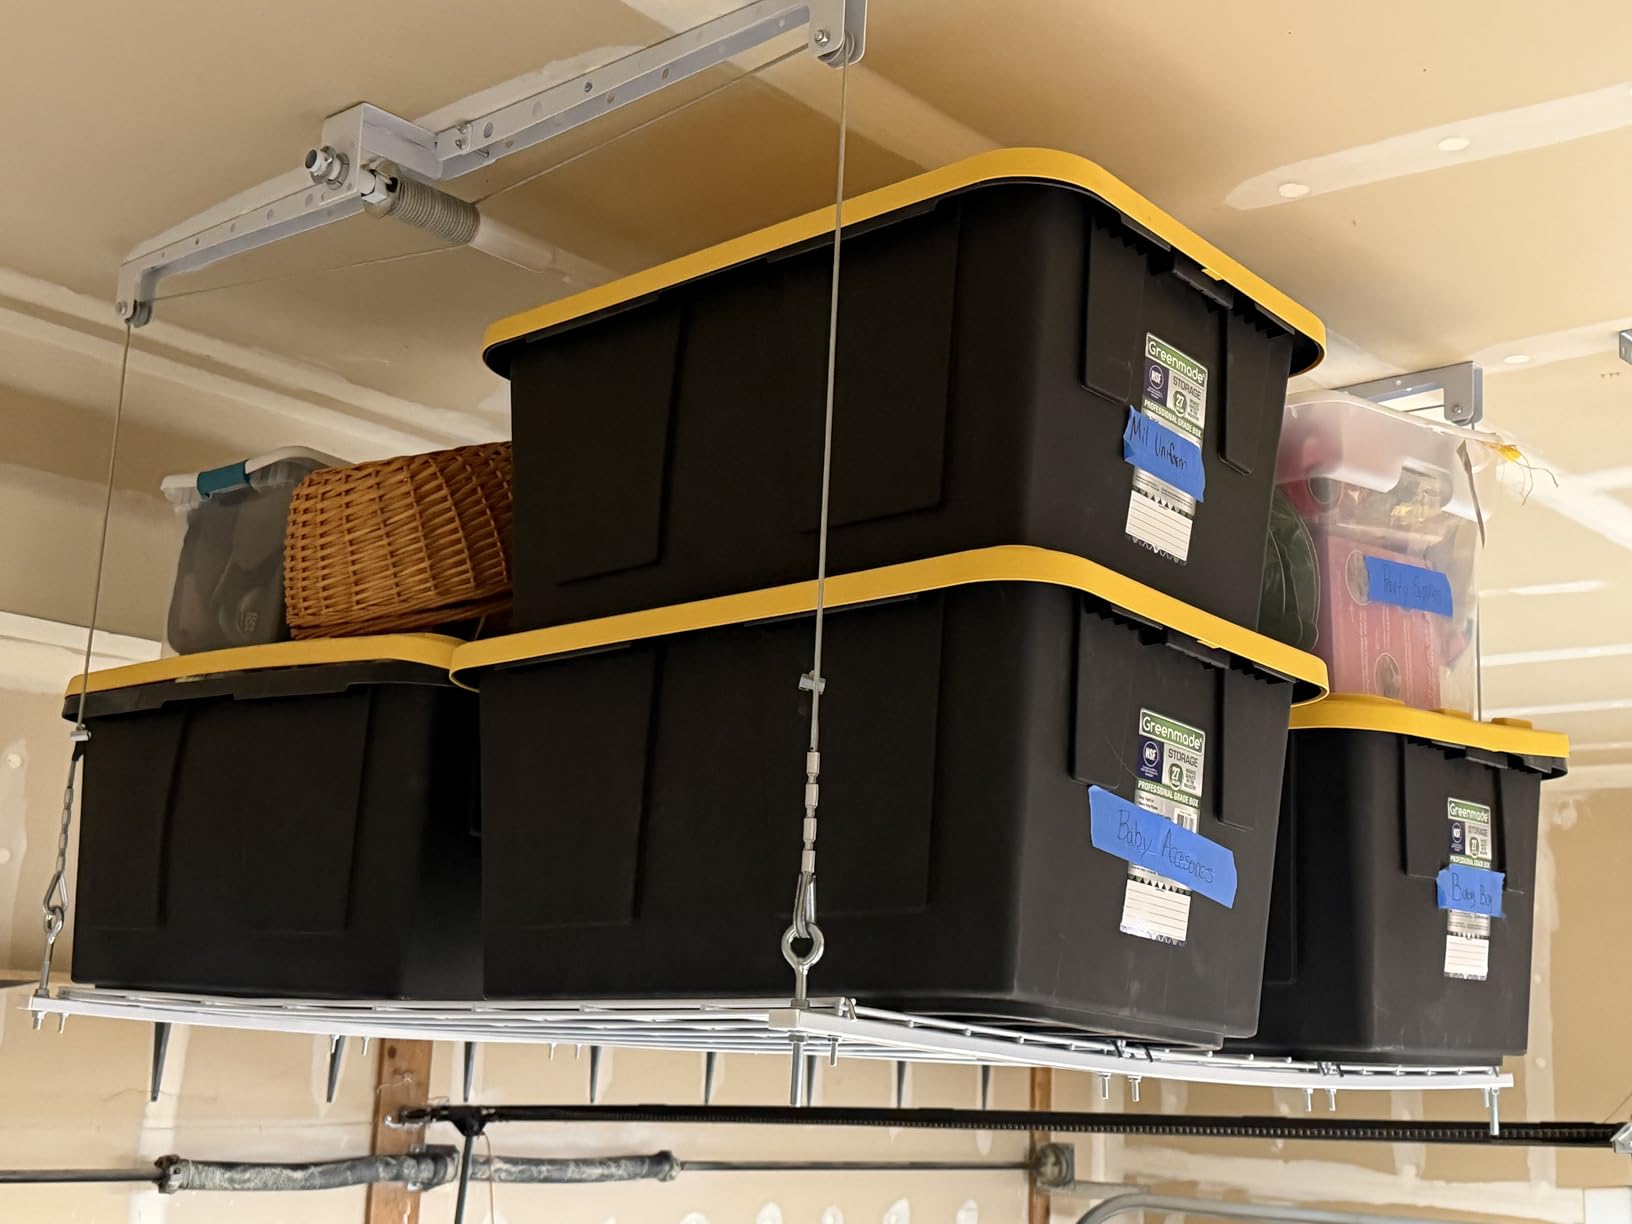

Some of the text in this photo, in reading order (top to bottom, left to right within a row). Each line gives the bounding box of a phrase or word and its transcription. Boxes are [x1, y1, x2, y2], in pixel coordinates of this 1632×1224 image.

[1148, 341, 1204, 384] Greenmade
[1172, 376, 1201, 400] STORAGE
[1175, 393, 1184, 408] 27
[1143, 398, 1178, 424] PROFESSIONAL
[1177, 418, 1193, 433] GRADE
[1192, 425, 1202, 437] BOX
[1130, 416, 1149, 446] Mil
[1142, 716, 1201, 750] Greenmade
[1145, 746, 1157, 761] NSF
[1168, 748, 1199, 768] STORAGE
[1171, 766, 1181, 781] 27
[1137, 780, 1174, 798] PROFESSIONAL
[1173, 791, 1189, 804] GRADE
[1188, 796, 1199, 808] BOX
[1450, 803, 1488, 822] Greenmade
[1117, 809, 1153, 860] Baby
